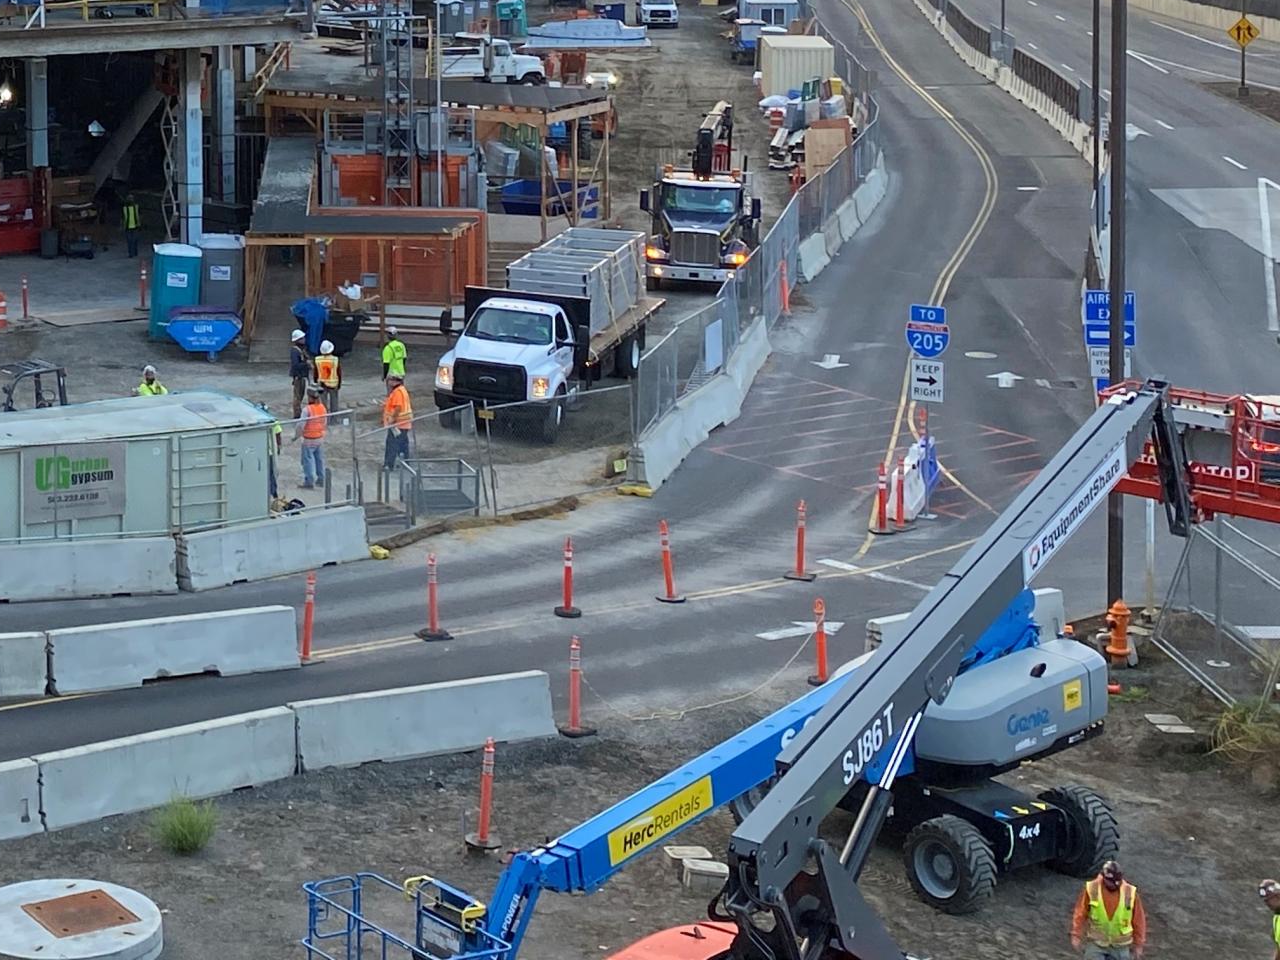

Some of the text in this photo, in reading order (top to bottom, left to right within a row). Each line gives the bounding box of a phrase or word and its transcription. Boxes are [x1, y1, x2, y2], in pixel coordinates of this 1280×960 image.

[919, 309, 936, 321] TO
[912, 332, 944, 351] 205
[915, 364, 940, 374] KEEP
[913, 386, 942, 398] RIGHT
[71, 469, 114, 486] gypsum
[1040, 458, 1122, 555] EquipmentShare
[1019, 822, 1041, 840] 4x4
